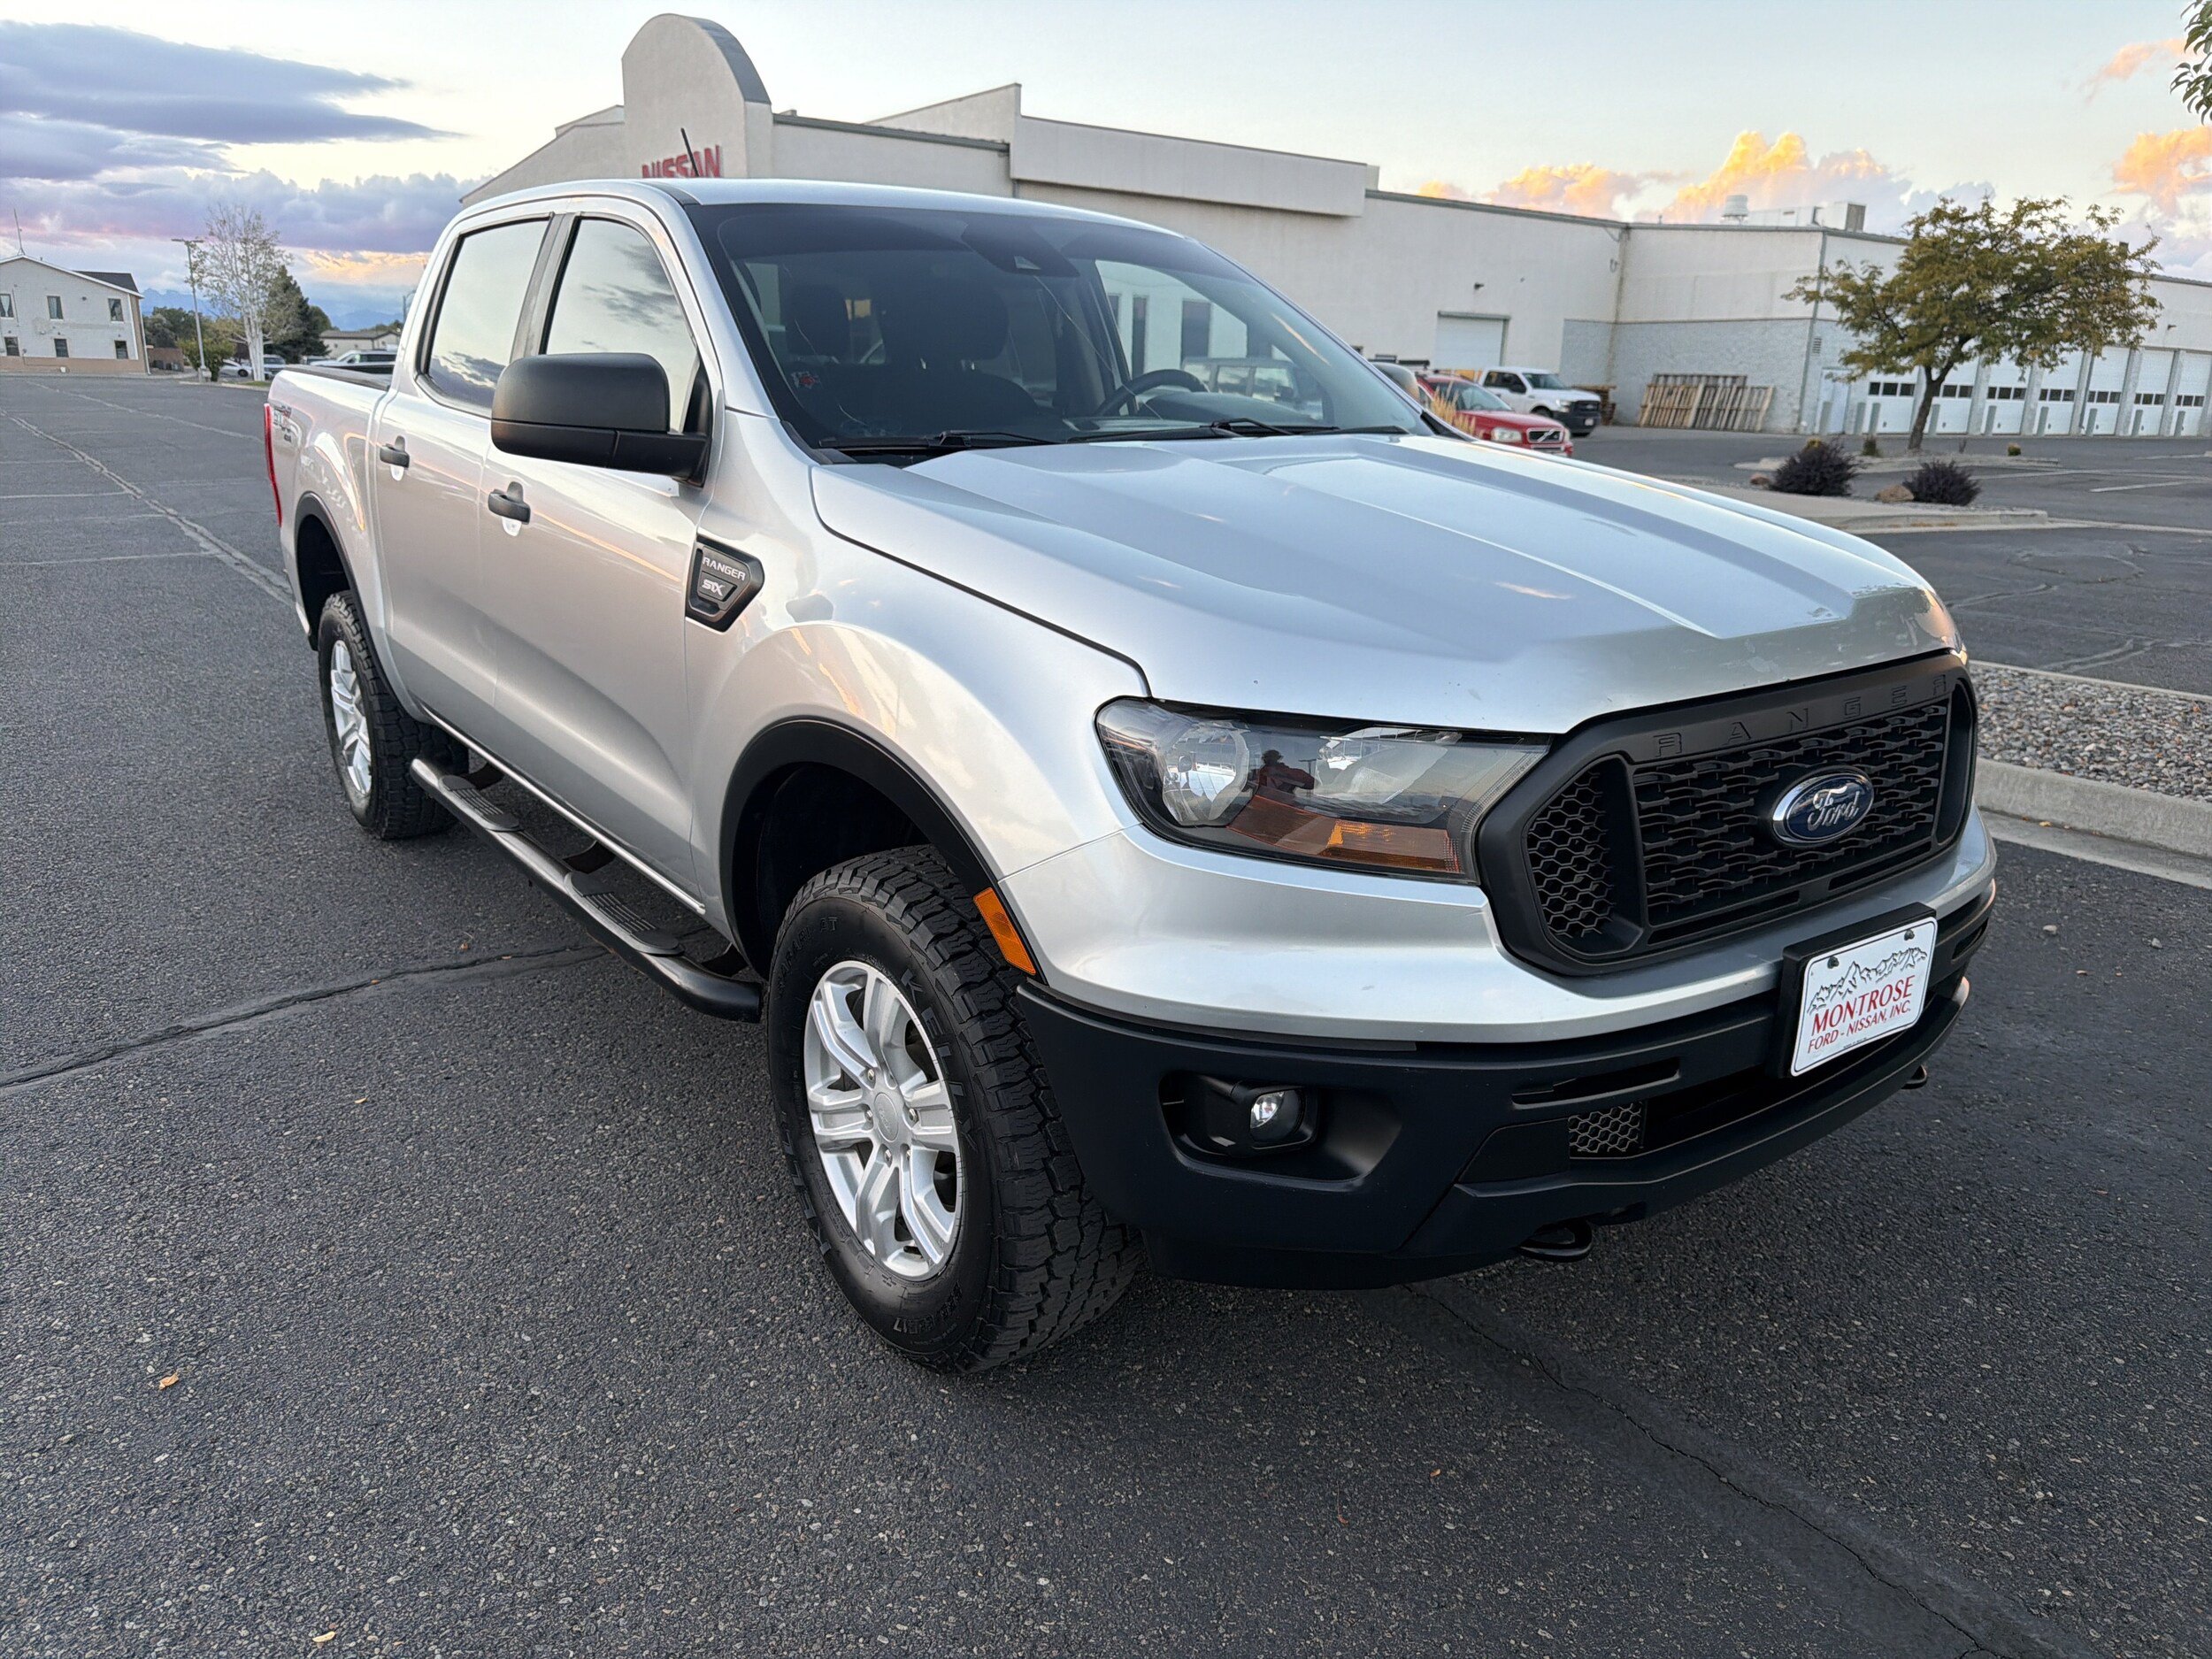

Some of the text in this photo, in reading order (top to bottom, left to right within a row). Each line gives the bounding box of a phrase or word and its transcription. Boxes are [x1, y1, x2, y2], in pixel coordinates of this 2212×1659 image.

[702, 557, 746, 580] RANGER
[702, 579, 725, 596] STX
[1651, 673, 1947, 758] RANGER
[1807, 783, 1863, 832] Ford
[1807, 1029, 1839, 1054] FORD
[1890, 1000, 1911, 1018] INC.
[1811, 974, 1916, 1037] MONTROSE
[901, 968, 978, 1150] KELLY
